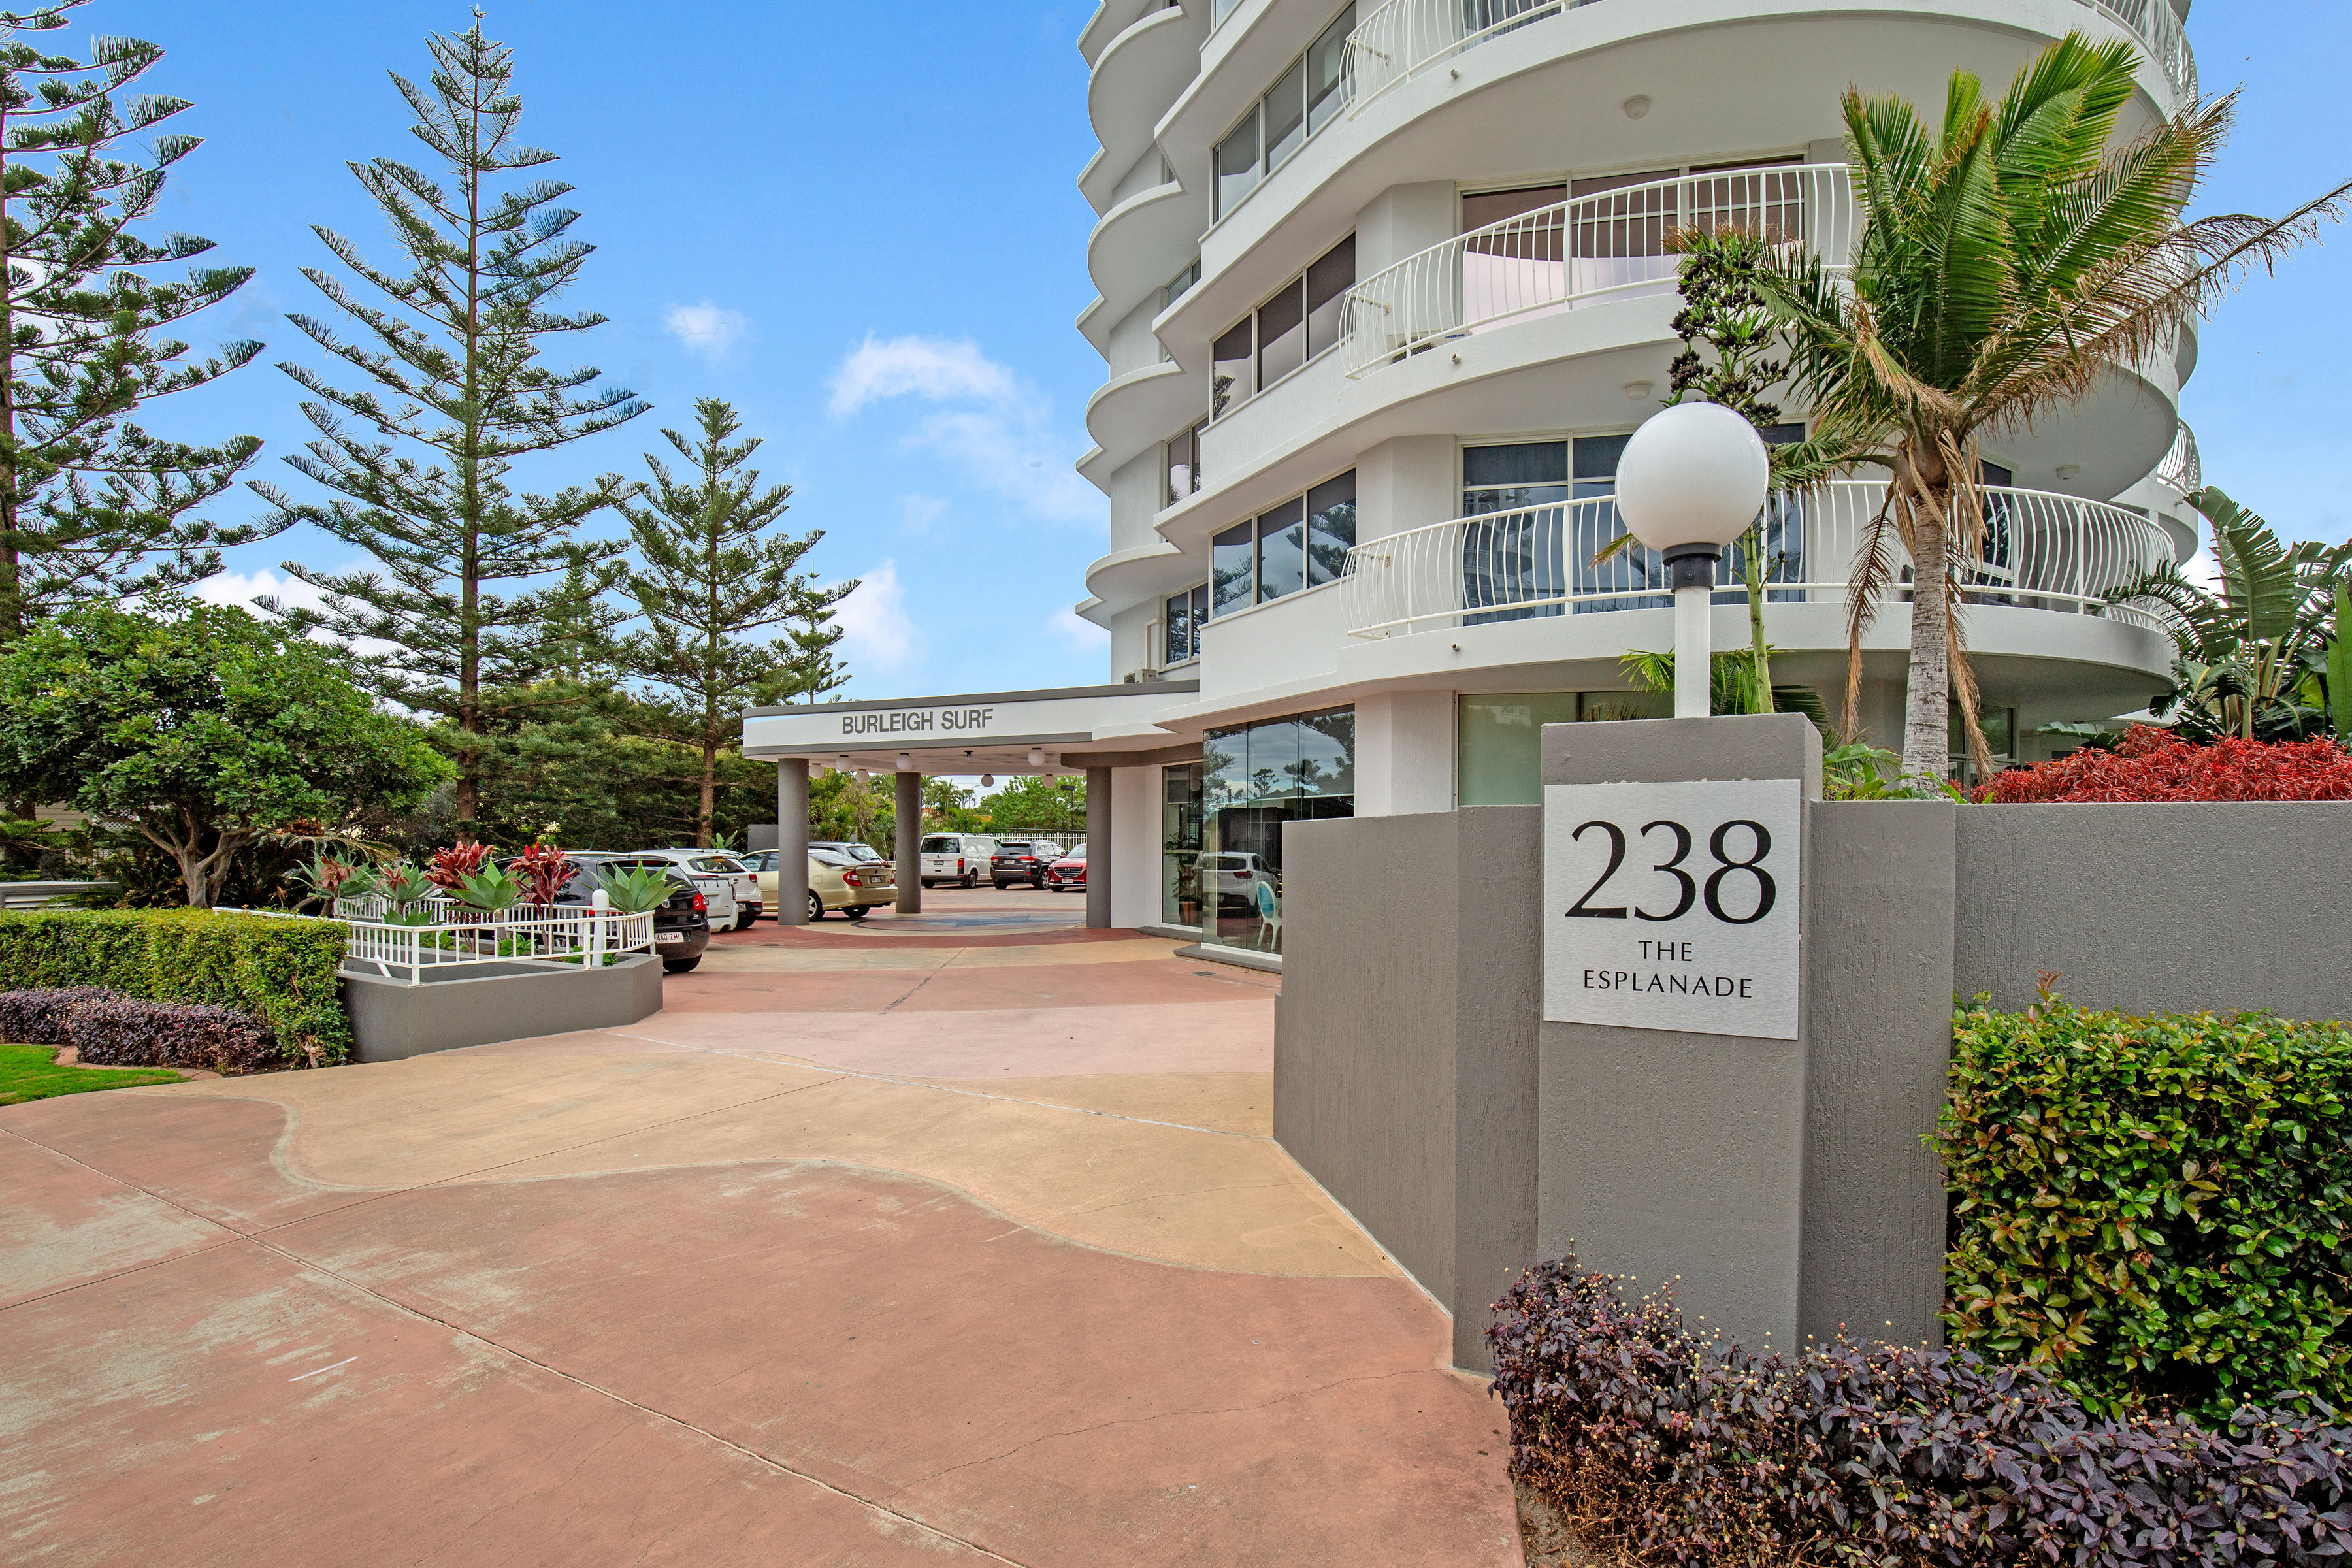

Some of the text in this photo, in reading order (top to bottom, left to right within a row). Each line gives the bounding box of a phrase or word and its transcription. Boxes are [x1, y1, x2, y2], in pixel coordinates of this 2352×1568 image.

[842, 708, 994, 734] BURLEIGH SURF
[1564, 819, 1776, 924] 238
[1638, 940, 1693, 962] THE
[1584, 970, 1752, 998] ESPLANADE
